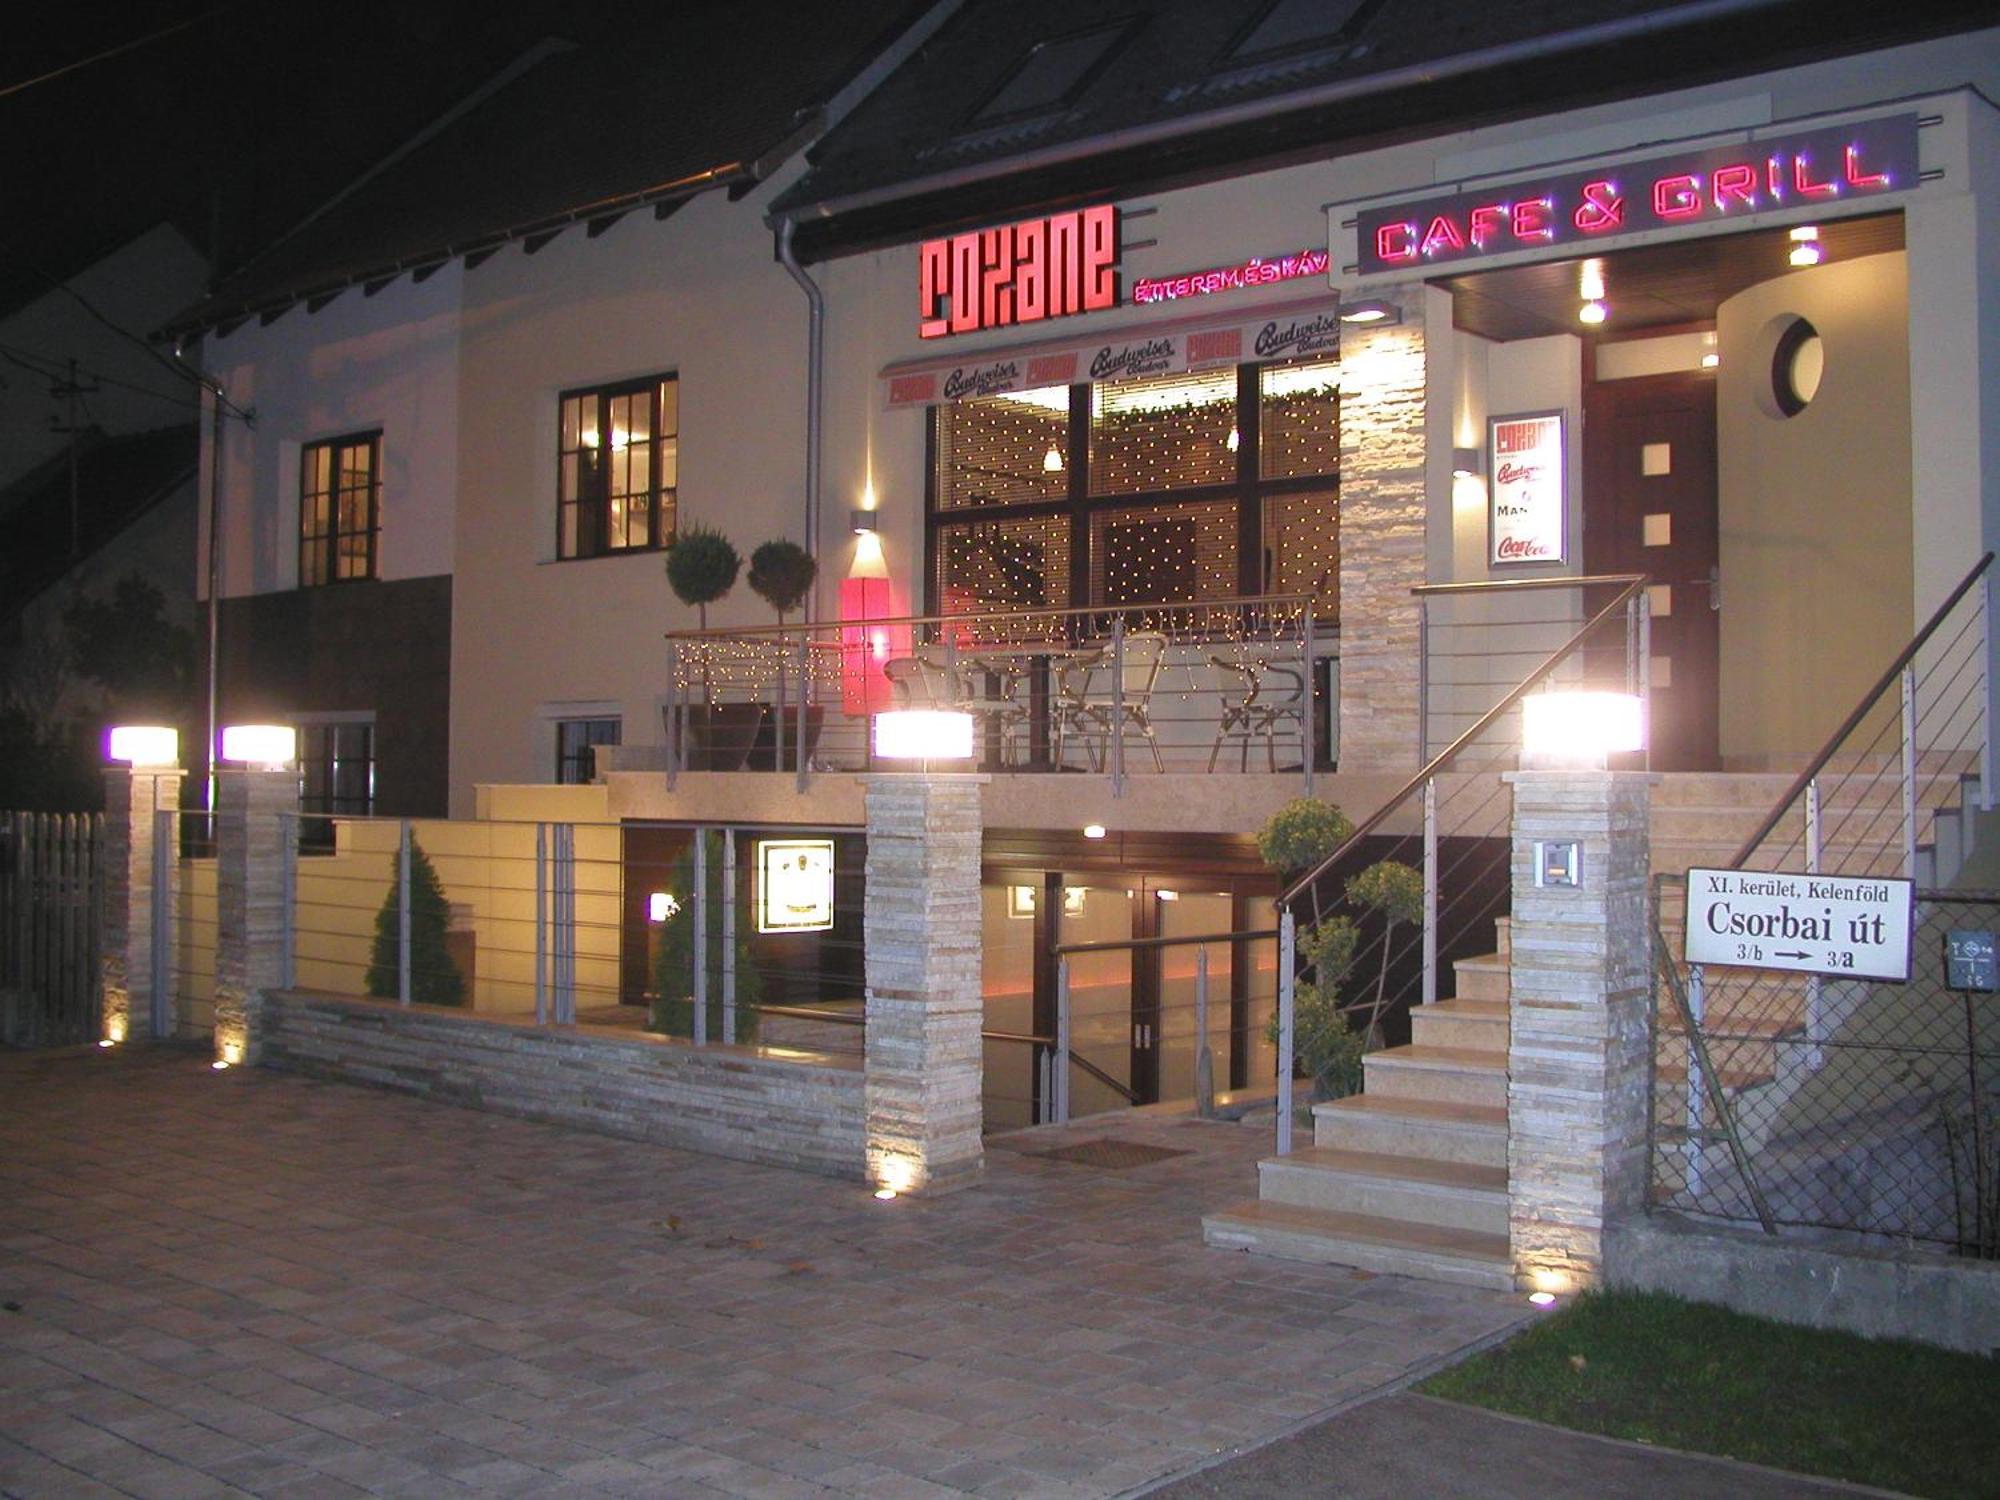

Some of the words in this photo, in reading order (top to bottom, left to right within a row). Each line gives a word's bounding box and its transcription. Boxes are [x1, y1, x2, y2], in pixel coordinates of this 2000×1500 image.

[1377, 197, 1552, 263] CAFE
[1574, 180, 1624, 230] &
[1653, 145, 1889, 218] GRILL
[1281, 250, 1329, 277] KÁV
[1254, 315, 1340, 357] Budweise
[1089, 338, 1175, 379] Budweiser
[943, 361, 1019, 399] Budweiser
[1707, 876, 1734, 894] XI.
[1739, 878, 1801, 899] kerület,
[1807, 882, 1889, 902] Kelenföld
[1707, 902, 1832, 941] Csorbai
[1849, 912, 1887, 945] út
[1827, 951, 1855, 968] 3/a
